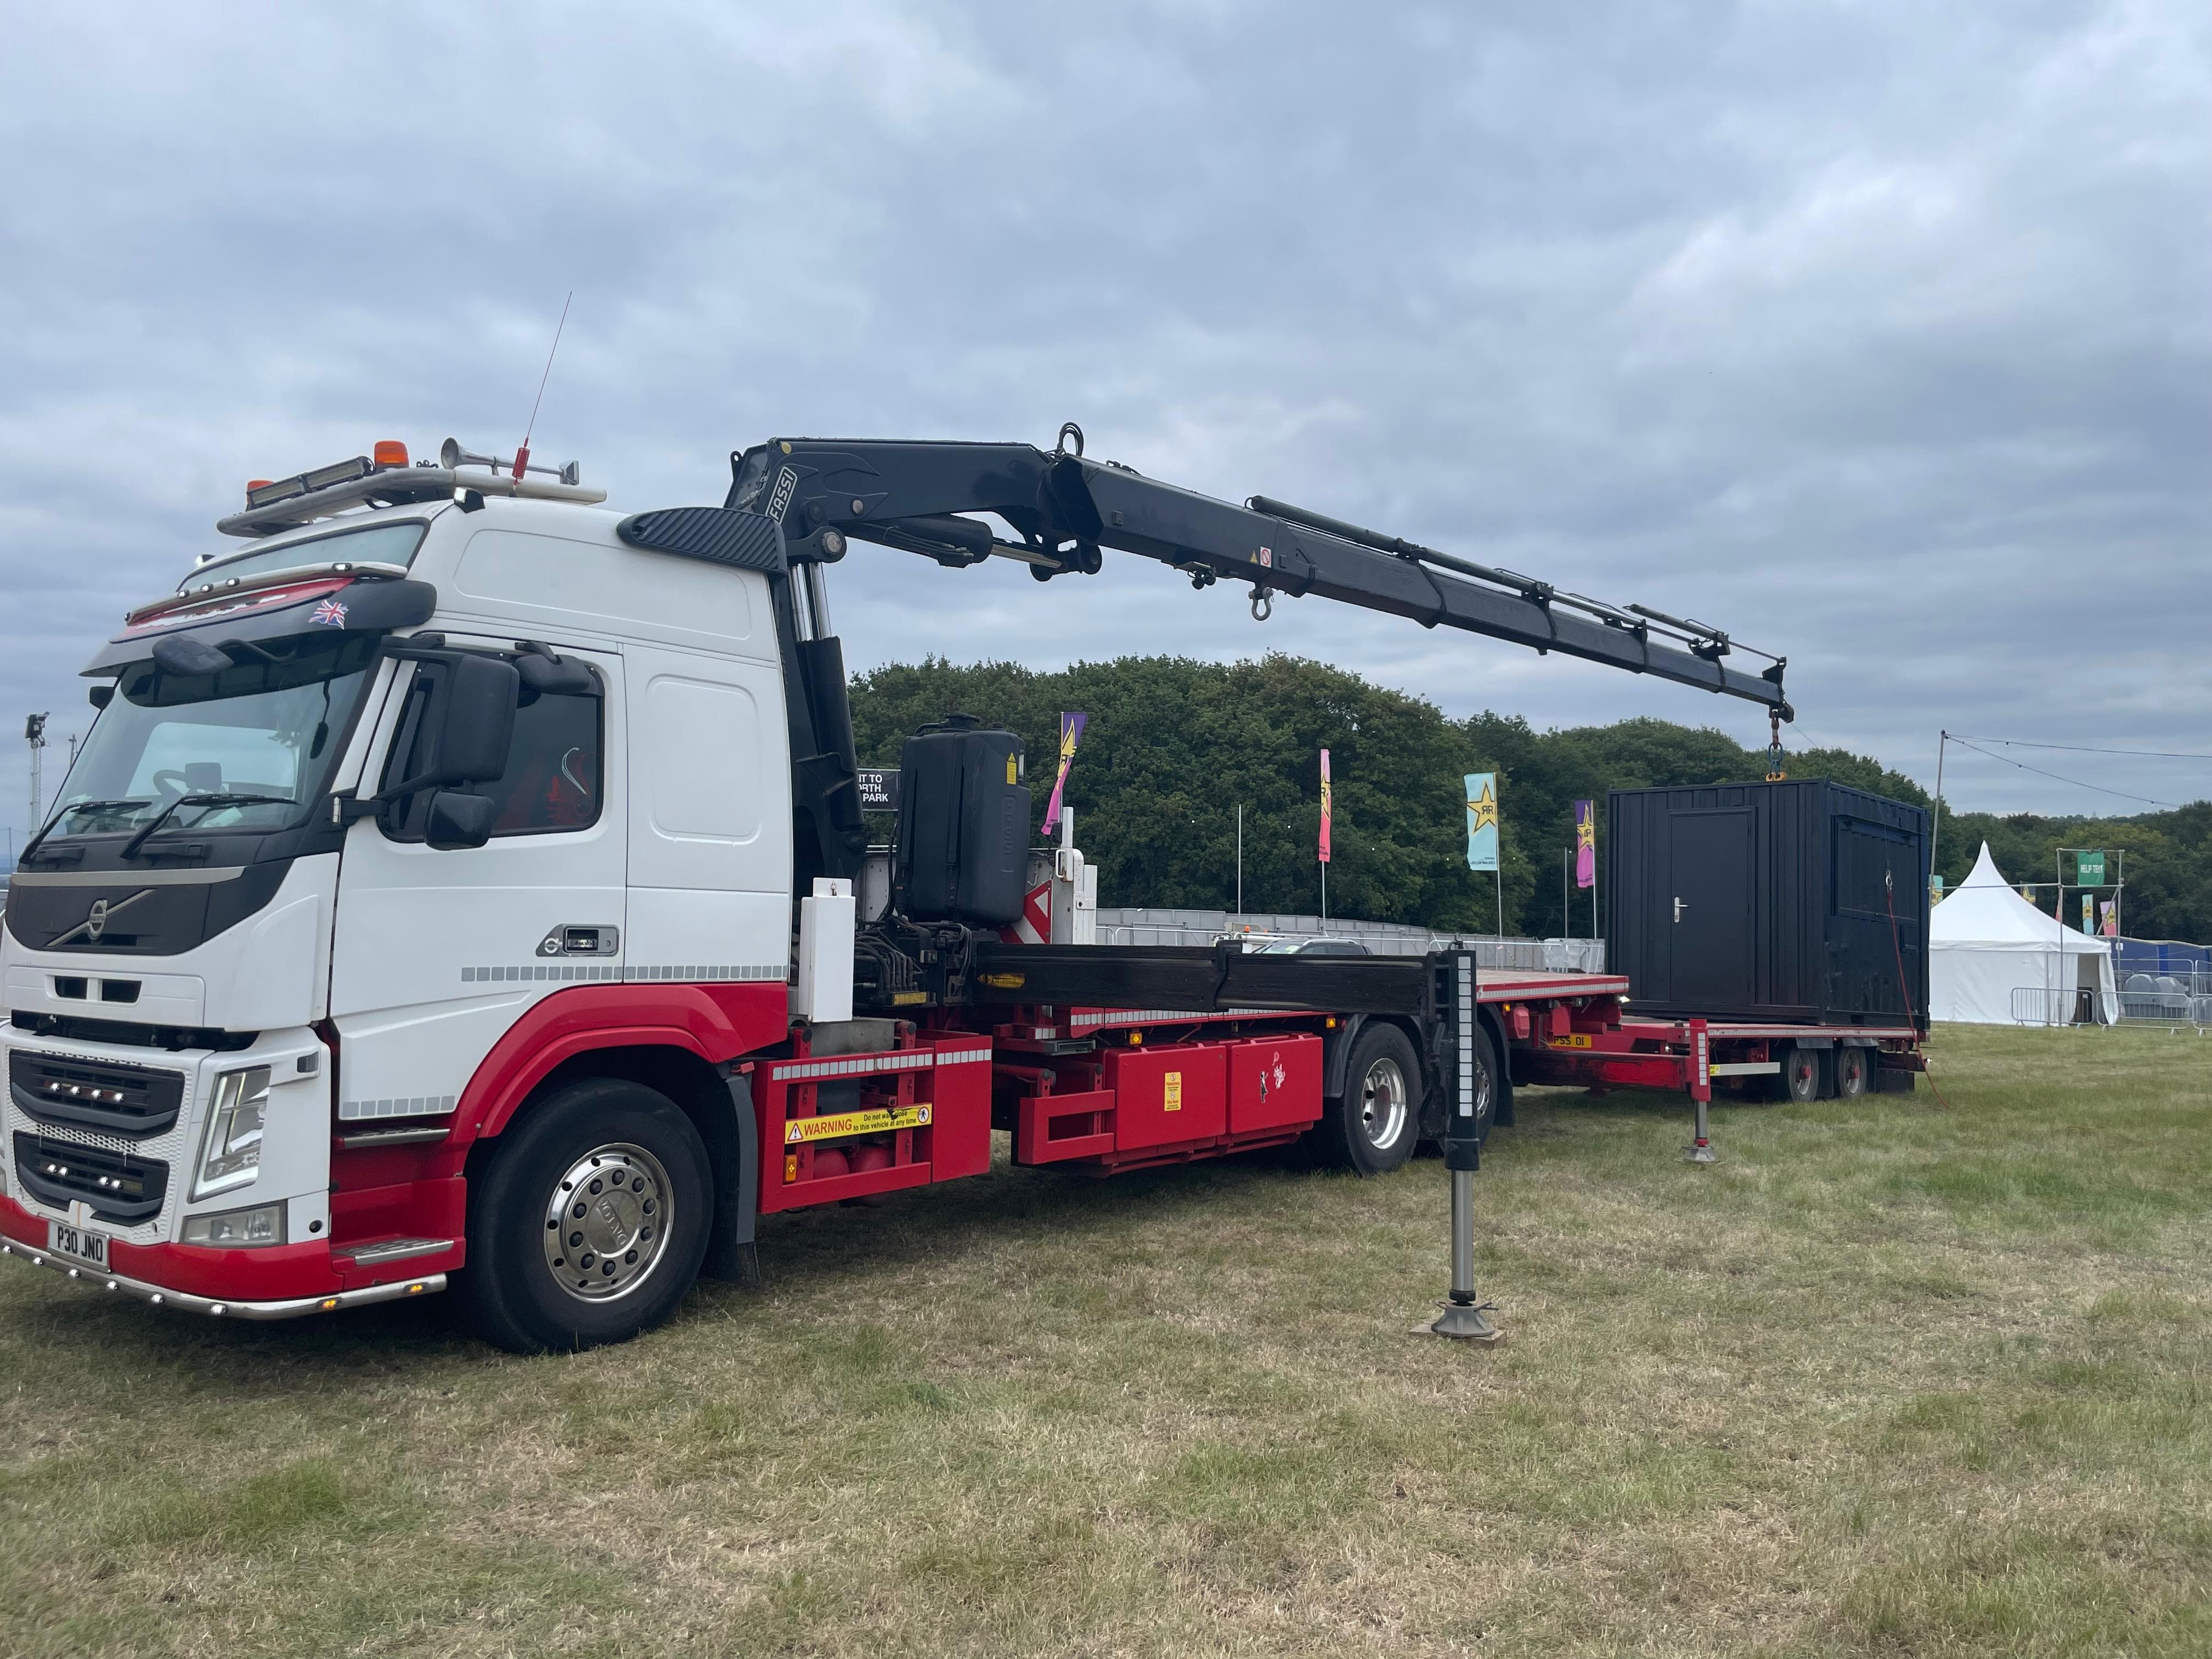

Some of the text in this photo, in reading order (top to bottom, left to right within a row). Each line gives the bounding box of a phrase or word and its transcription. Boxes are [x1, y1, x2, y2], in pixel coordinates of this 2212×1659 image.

[770, 472, 793, 520] FASSI
[869, 774, 883, 783] TO
[859, 784, 881, 792] RTH
[863, 793, 888, 802] PARK
[804, 1119, 852, 1136] WARNING
[871, 1120, 888, 1128] vehicle
[58, 1226, 103, 1261] P30 JNO
